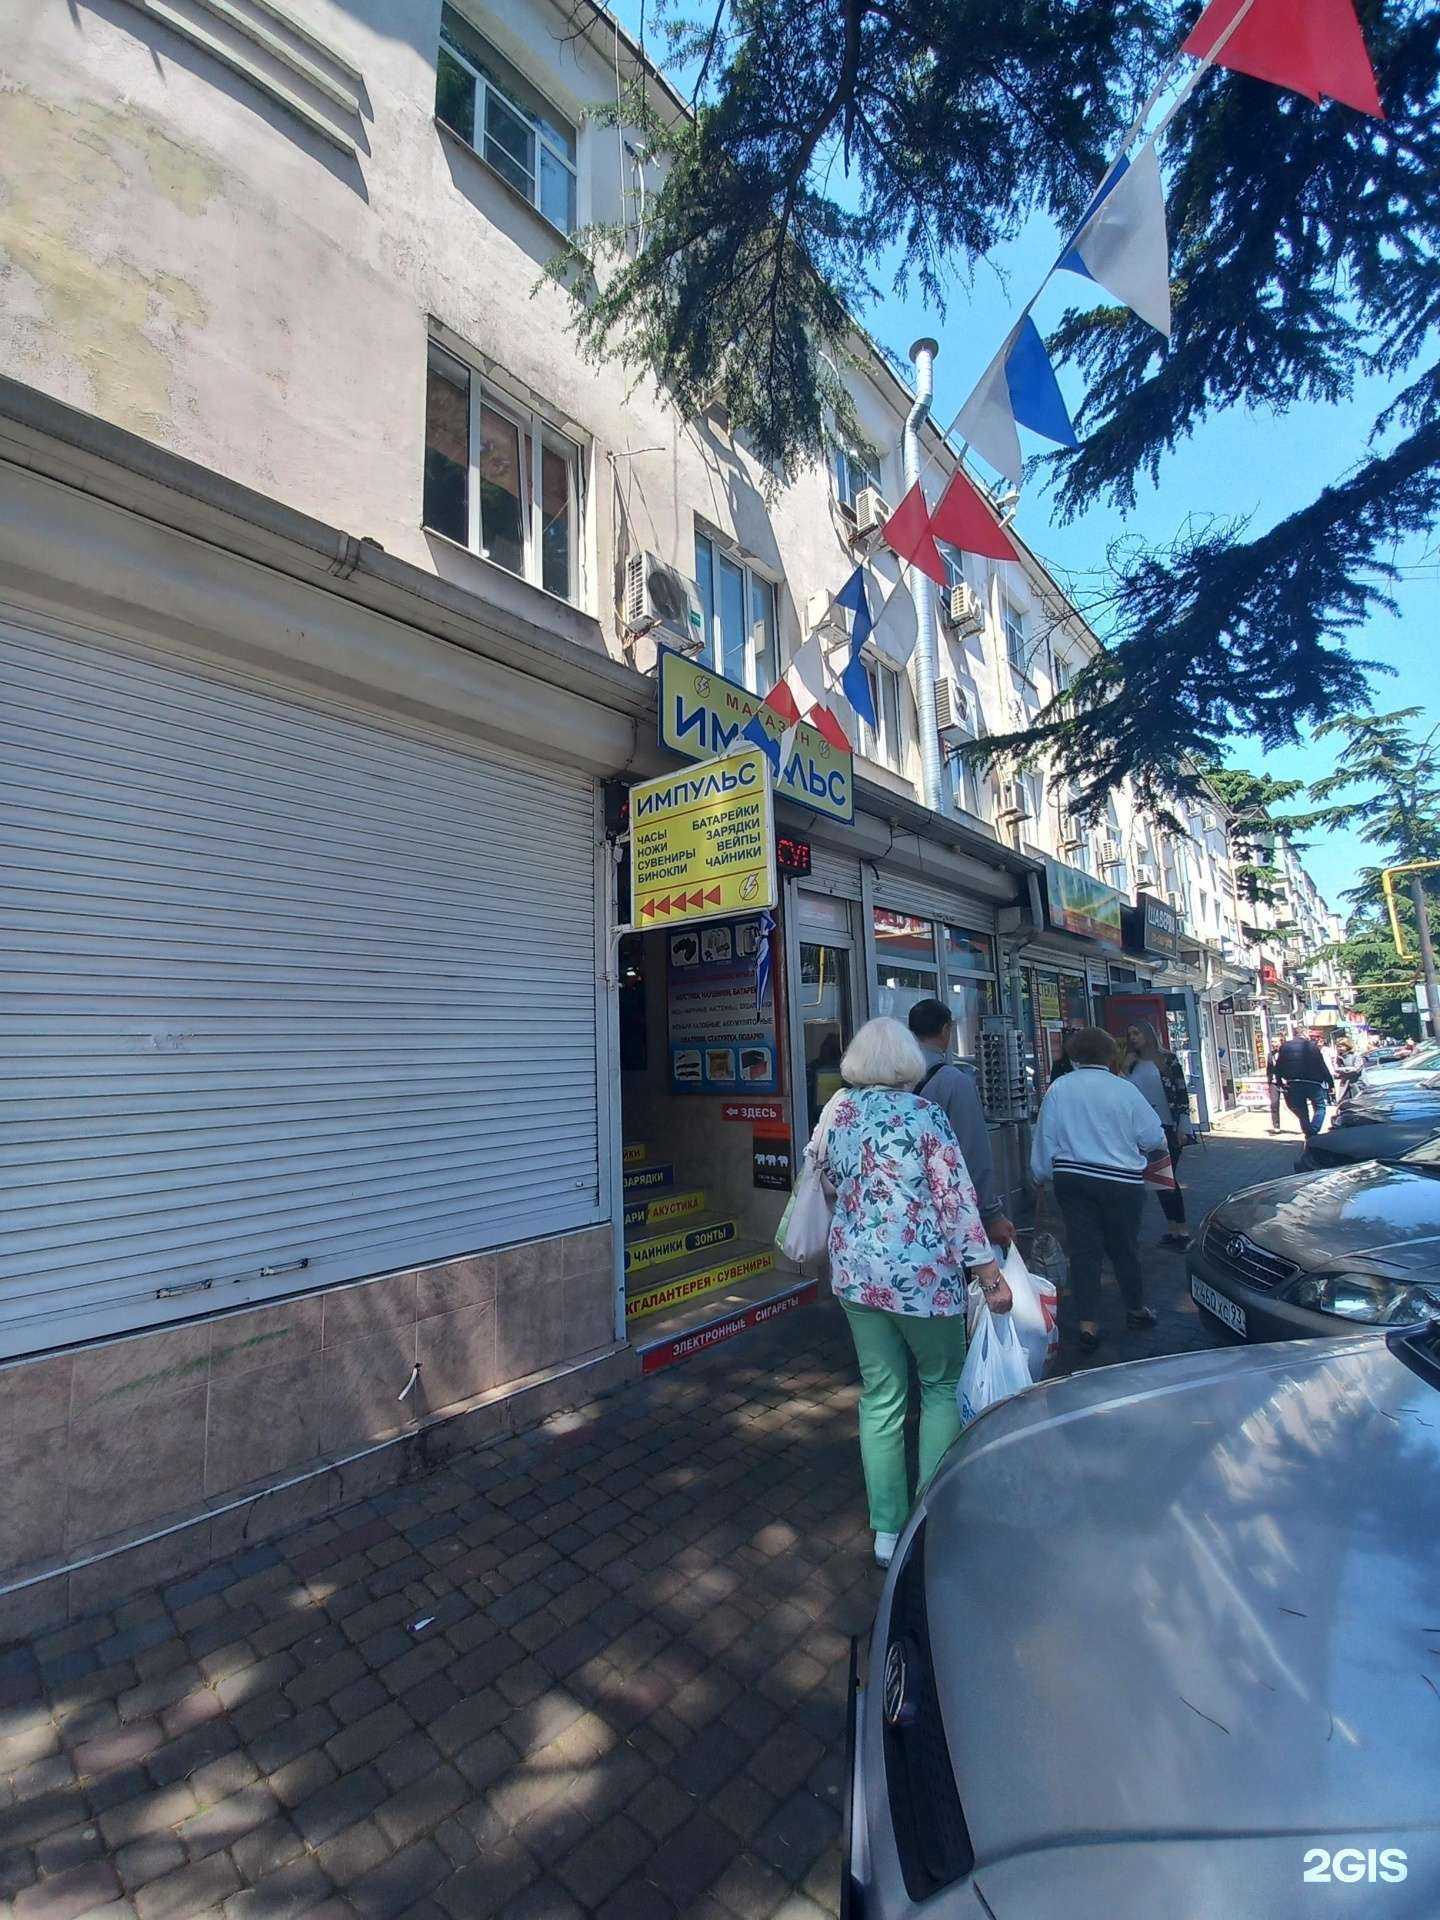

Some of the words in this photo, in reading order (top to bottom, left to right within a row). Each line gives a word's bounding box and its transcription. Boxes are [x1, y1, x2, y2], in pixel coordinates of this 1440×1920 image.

[676, 695, 846, 806] ИМЛЬС
[637, 762, 756, 816] ИМПУЛЬС
[692, 804, 760, 831] БАТАРЕЙКИ
[637, 829, 667, 844] ЧАСЫ
[706, 818, 760, 841] ЗАРЯДКИ
[637, 842, 668, 858] НОЖИ
[717, 832, 761, 852] ВЕЙПЫ
[637, 849, 696, 871] СУВЕНИРЫ
[705, 846, 762, 868] ЧАЙНИКИ
[638, 863, 688, 883] БИНОКЛИ
[741, 1108, 777, 1118] ЗДЕСЬ
[624, 1172, 663, 1188] ЗАРЯДКИ
[652, 1200, 699, 1217] АКУСТИКА
[633, 1239, 683, 1263] ЧАЙНИКИ
[694, 1227, 727, 1246] ЗОНТЫ
[717, 1256, 772, 1284] СУВЕНИРЫ
[672, 1318, 746, 1356] ЭЛЕКТРОННЫЕ
[755, 1296, 800, 1322] СИГАРЕТЫ
